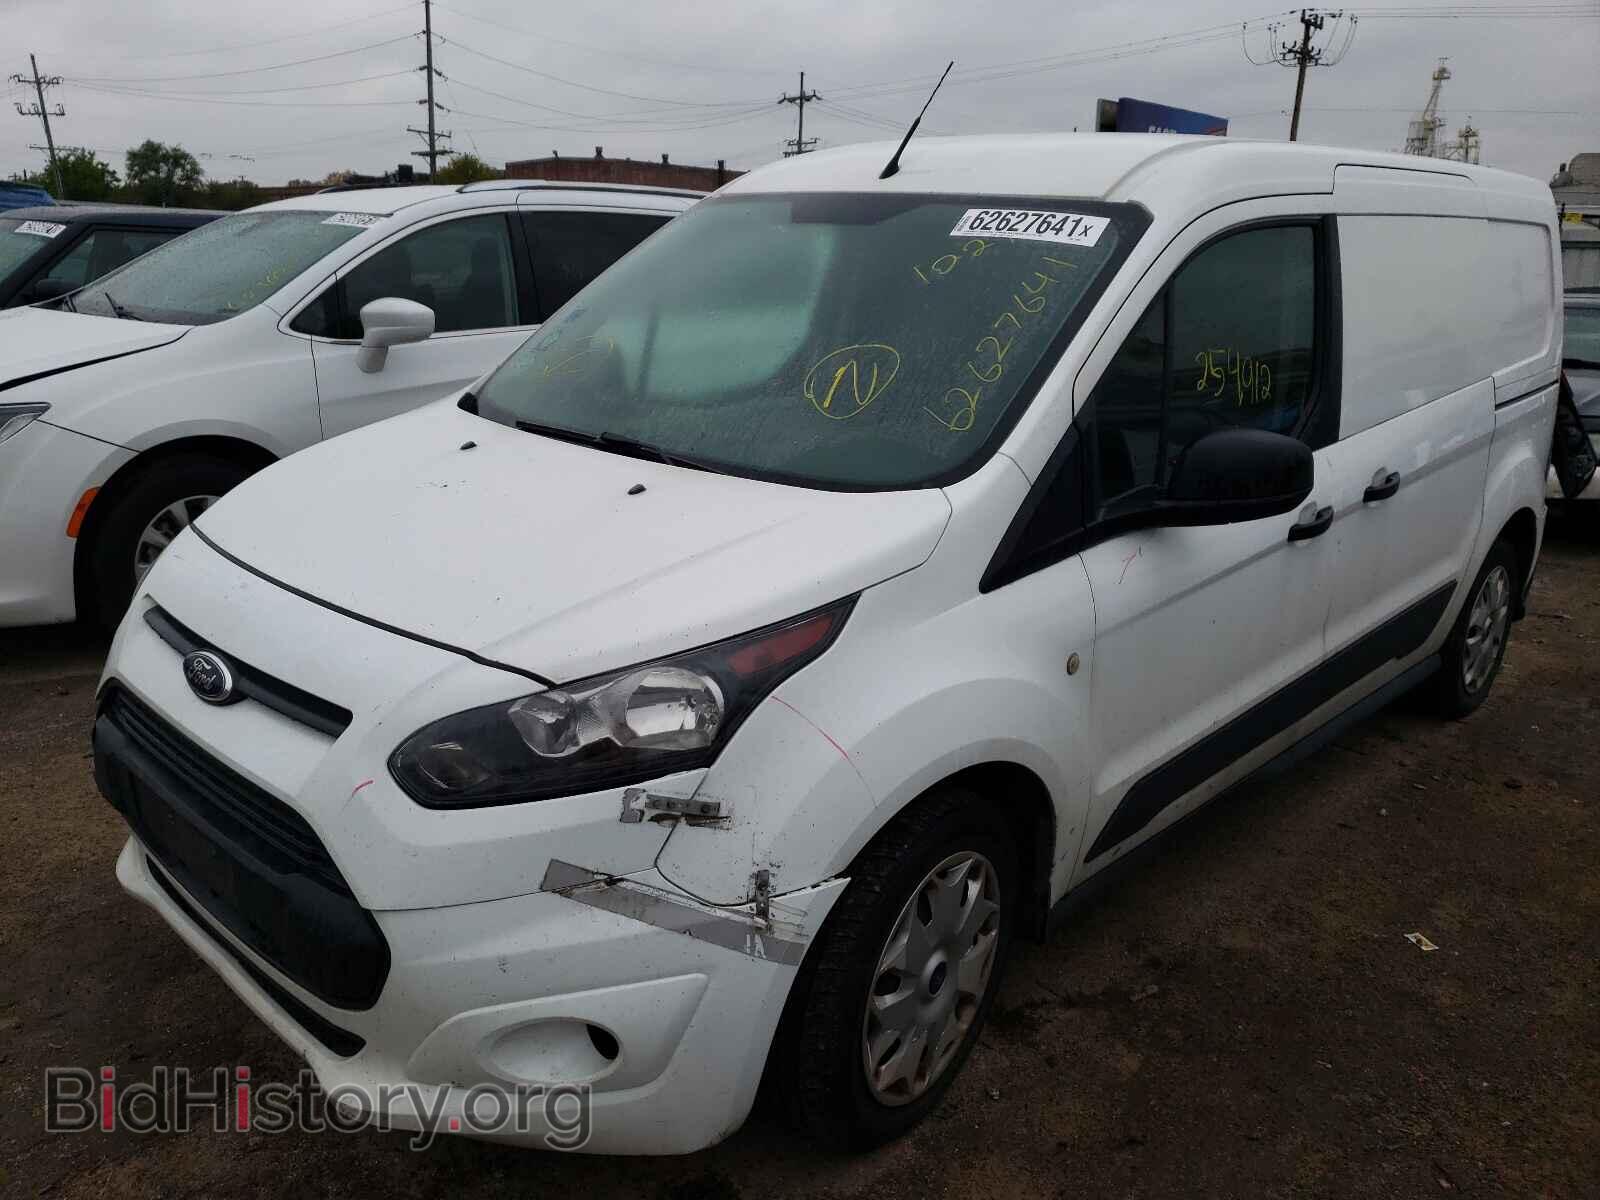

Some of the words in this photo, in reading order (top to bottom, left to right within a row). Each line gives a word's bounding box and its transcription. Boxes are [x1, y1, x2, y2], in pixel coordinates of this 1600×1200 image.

[968, 210, 1084, 238] 62627641
[913, 239, 993, 284] 102
[922, 256, 1079, 431] 62627641
[823, 360, 878, 408] N
[192, 657, 217, 690] Ford
